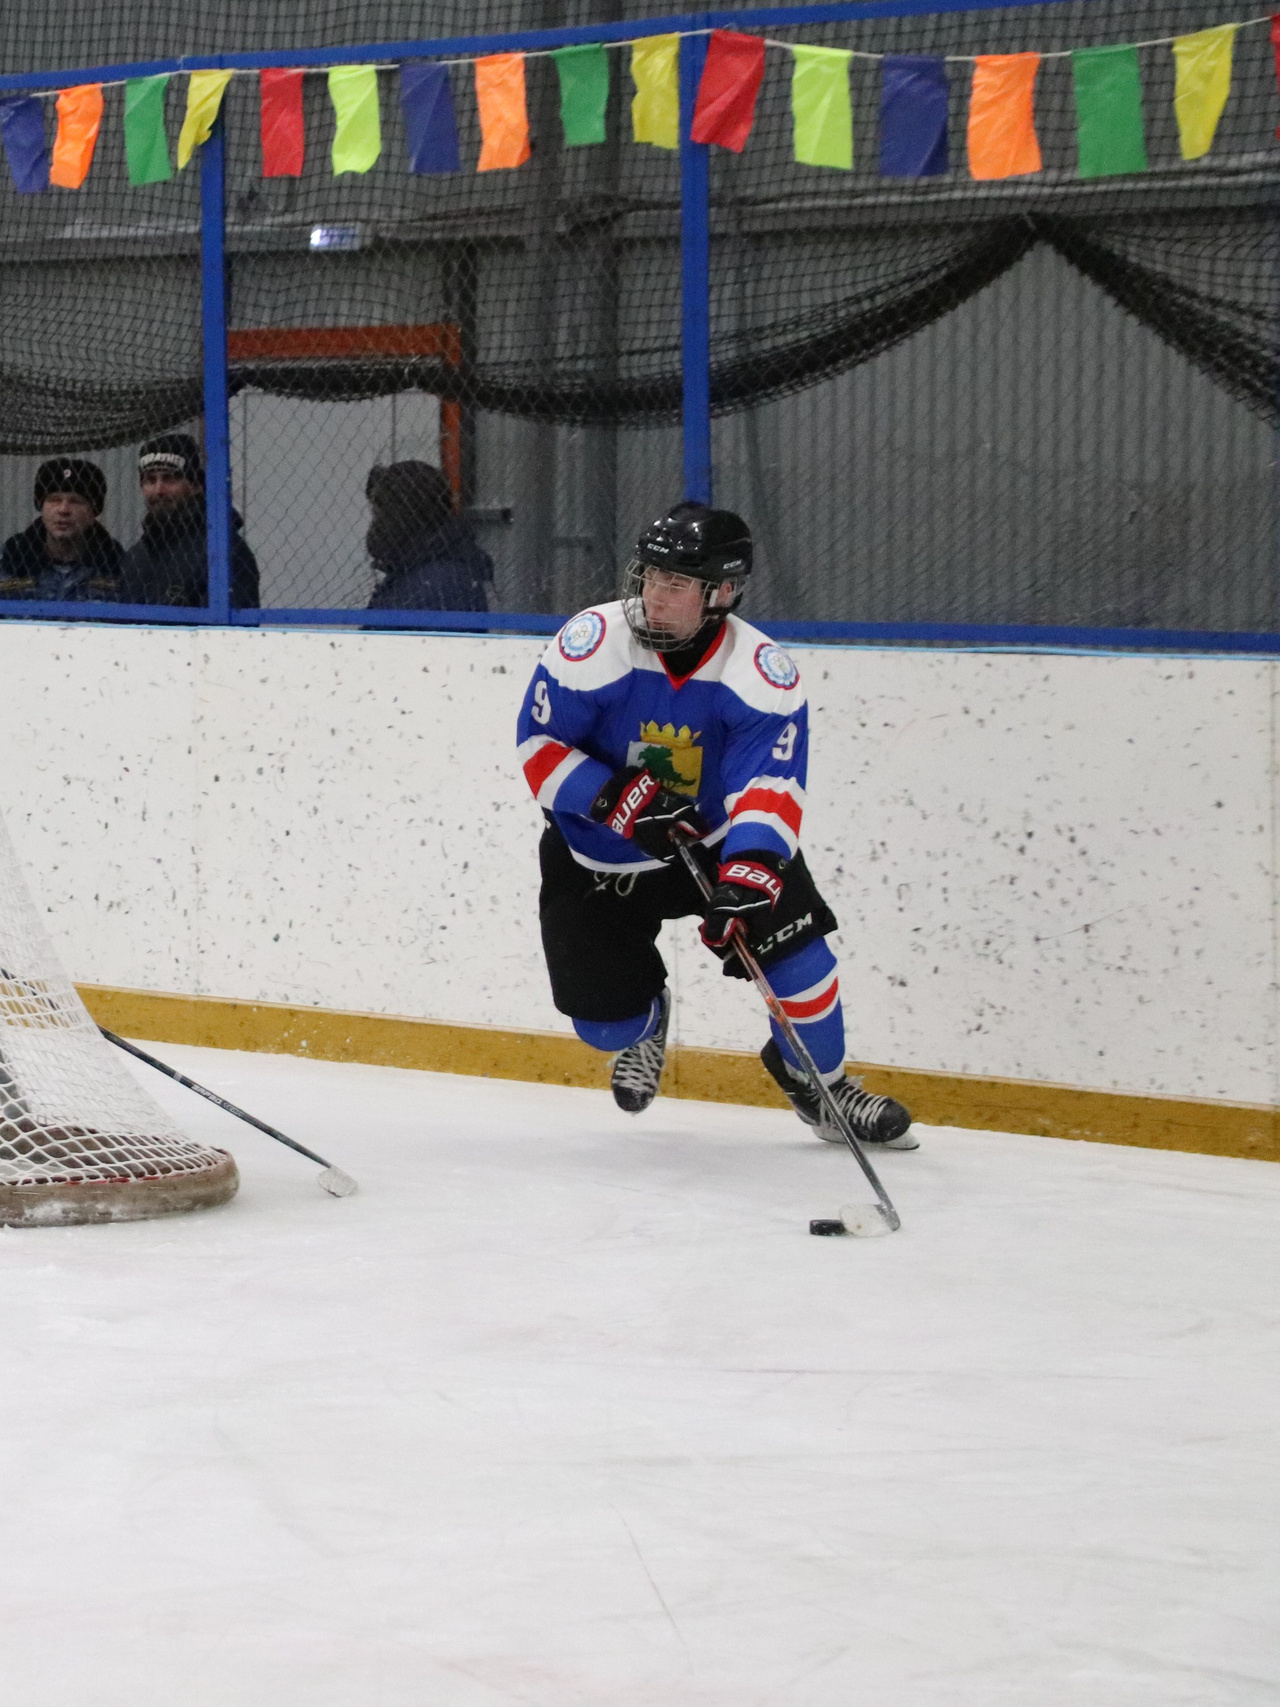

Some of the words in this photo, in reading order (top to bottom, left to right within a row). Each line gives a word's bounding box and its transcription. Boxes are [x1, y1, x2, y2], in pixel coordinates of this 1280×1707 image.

[646, 542, 670, 554] CCM
[722, 559, 742, 570] CCM
[531, 680, 552, 725] 9
[772, 721, 798, 761] 9
[611, 774, 655, 835] AUER
[726, 864, 781, 906] BAU
[757, 912, 813, 955] CCM
